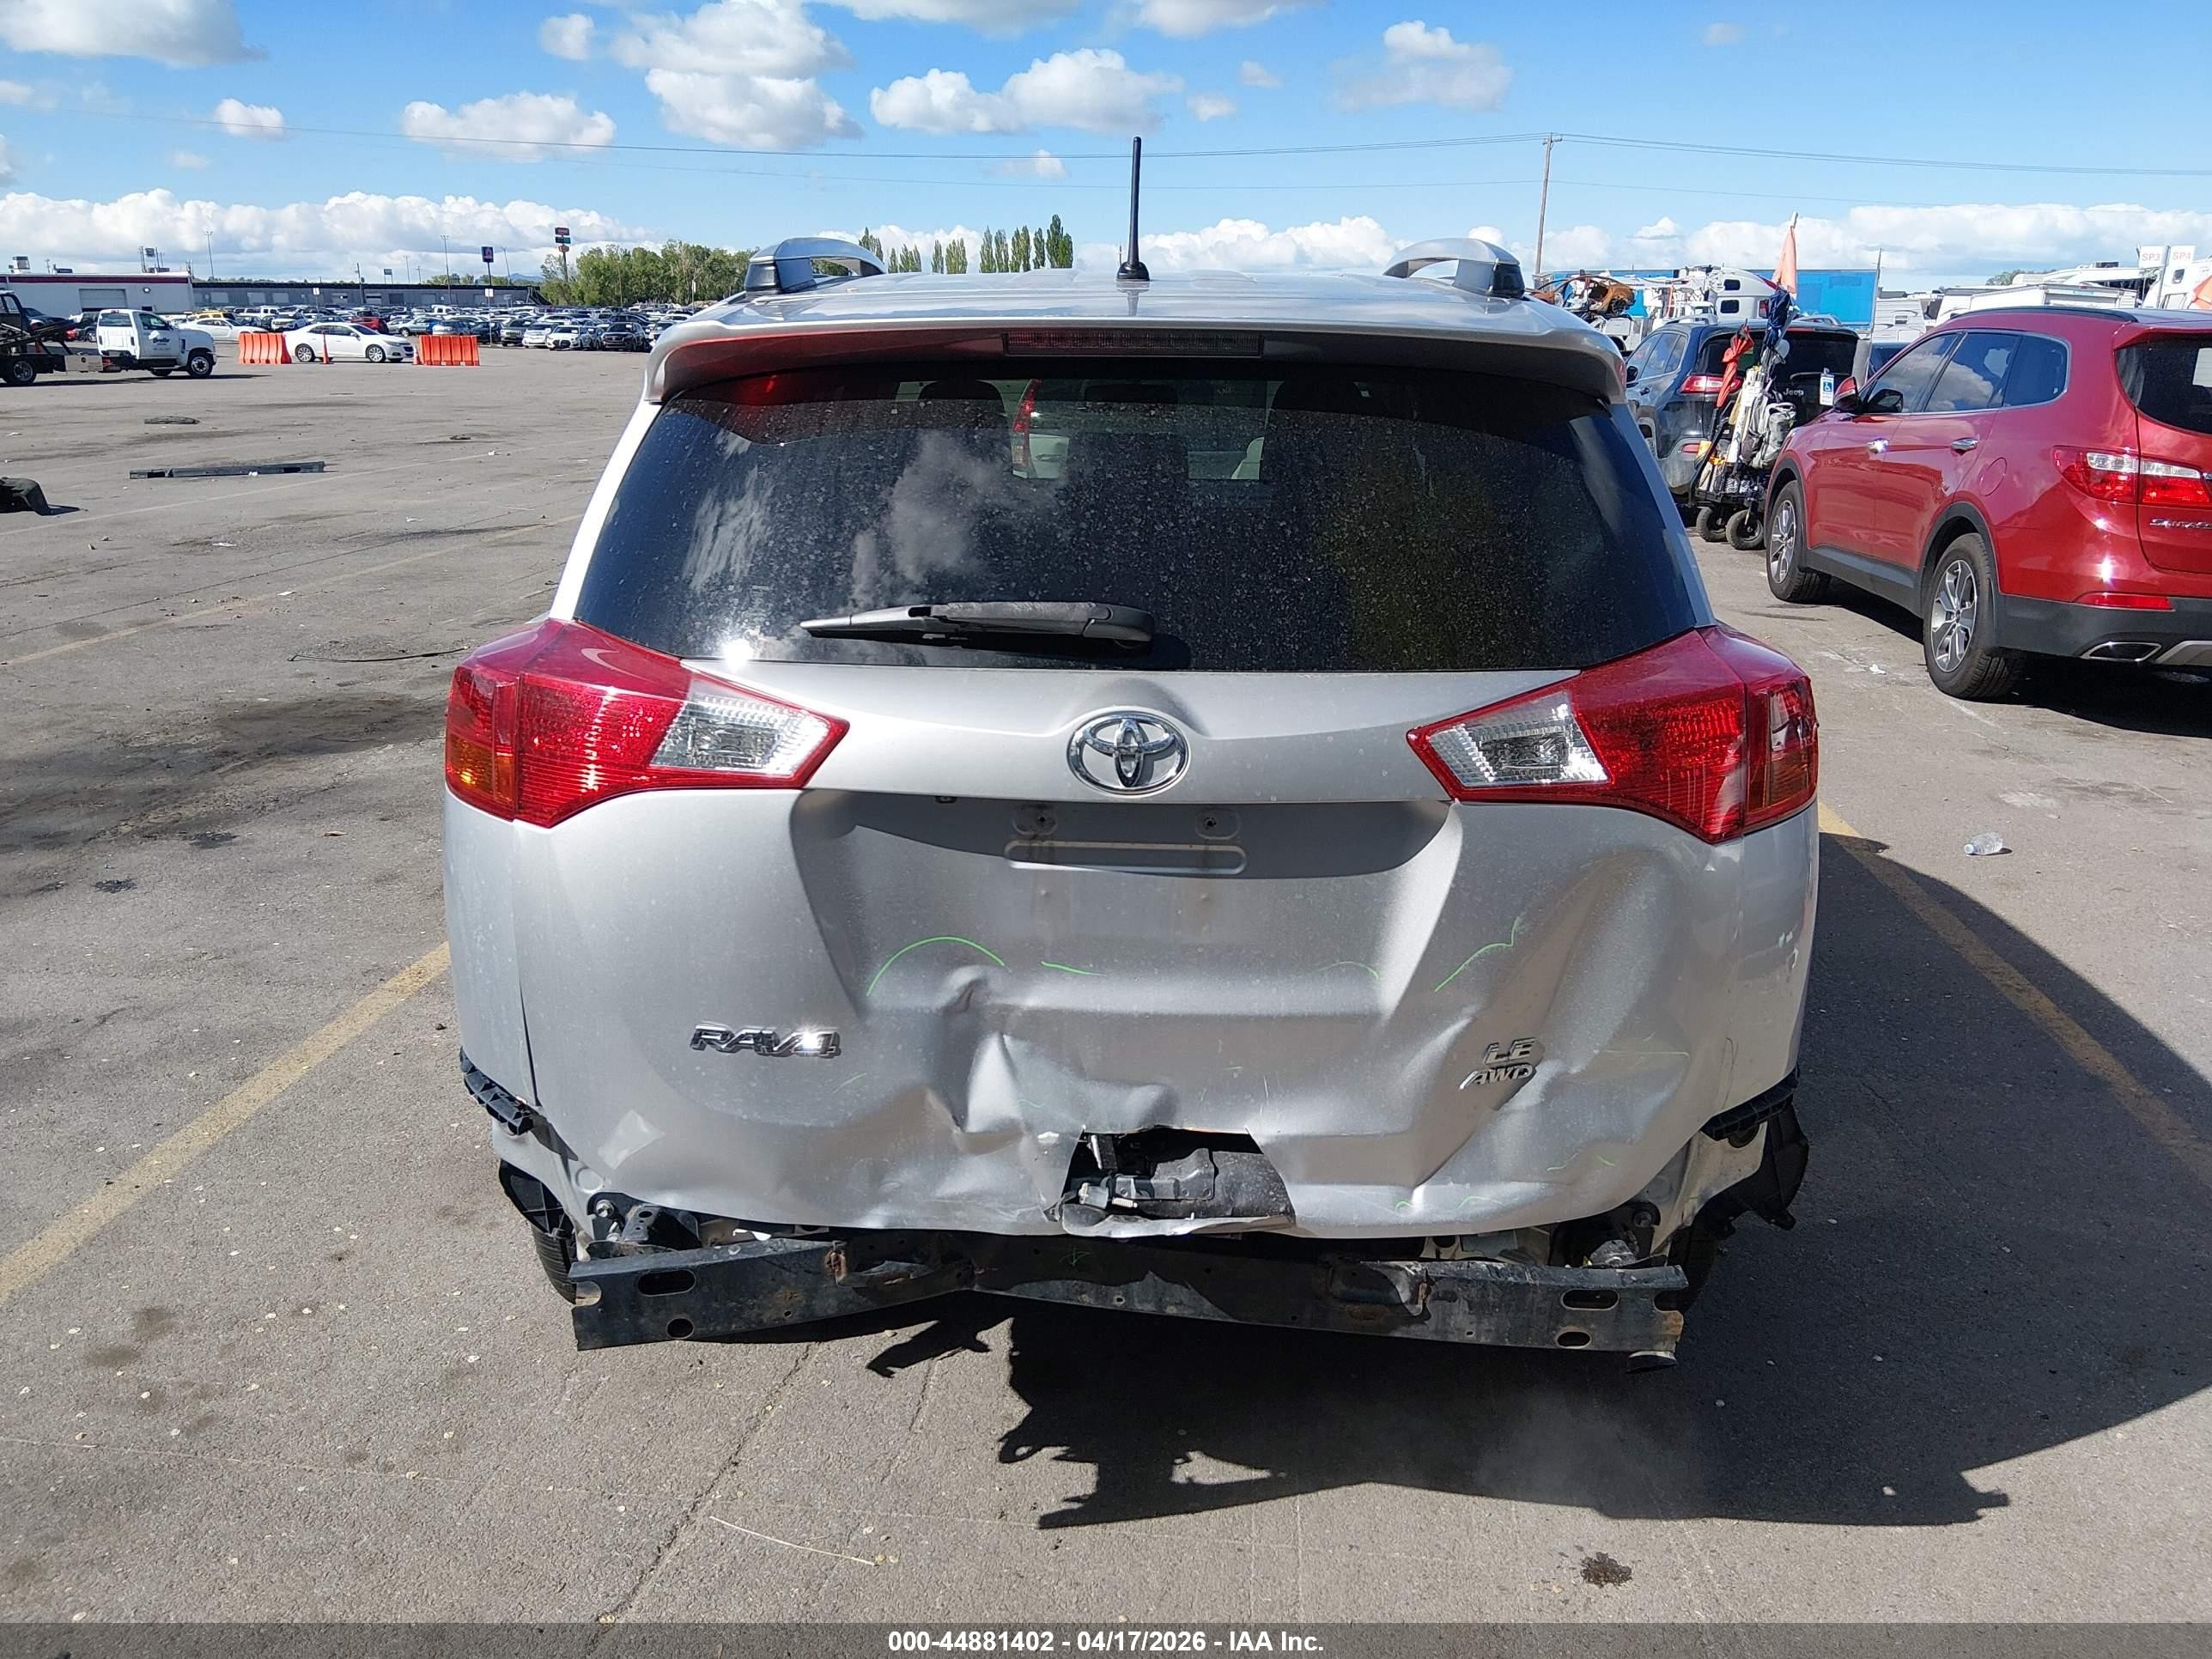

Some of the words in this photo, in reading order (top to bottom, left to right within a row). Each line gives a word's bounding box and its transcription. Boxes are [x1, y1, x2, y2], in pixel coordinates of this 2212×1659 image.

[2172, 252, 2191, 260] SP4
[1783, 387, 1805, 397] Jeep
[690, 1021, 842, 1059] RAV4
[1484, 1037, 1535, 1065] LE
[1459, 1063, 1534, 1090] AWD
